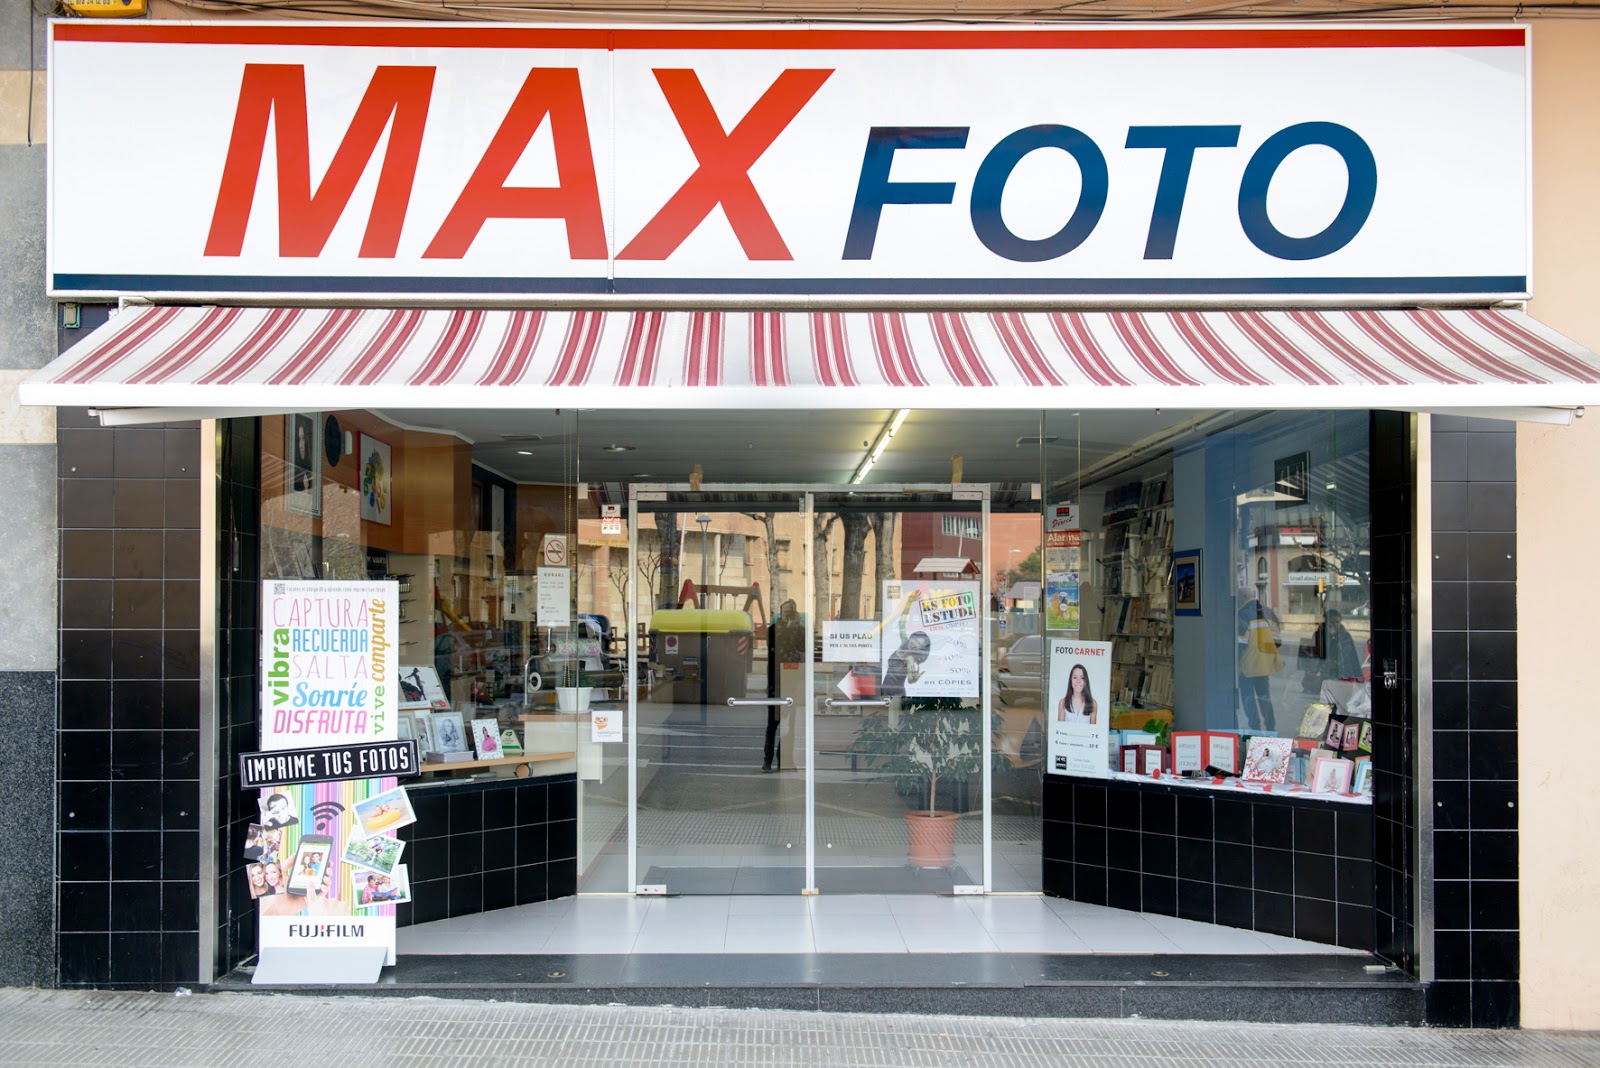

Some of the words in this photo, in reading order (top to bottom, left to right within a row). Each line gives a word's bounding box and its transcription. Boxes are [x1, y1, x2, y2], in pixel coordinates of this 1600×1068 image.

[203, 63, 836, 261] MAX
[842, 121, 1378, 262] FOTO
[1047, 532, 1080, 542] Alarma
[273, 598, 369, 628] CAPTURA
[941, 594, 971, 609] FOTO
[923, 606, 973, 624] ESTUDI
[292, 629, 368, 652] RECUERDA
[368, 598, 391, 683] comparte
[1055, 646, 1074, 655] FOTO
[1074, 647, 1106, 656] CARNET
[268, 628, 289, 706] vibra
[292, 655, 368, 679] SALTA
[292, 681, 368, 708] Sonríe
[273, 709, 368, 734] DISFRUTA
[370, 685, 385, 735] vive
[247, 754, 317, 782] IMPRIME
[322, 751, 353, 775] TUS
[359, 746, 409, 773] FOTOS
[289, 924, 364, 938] FUJIFILM
